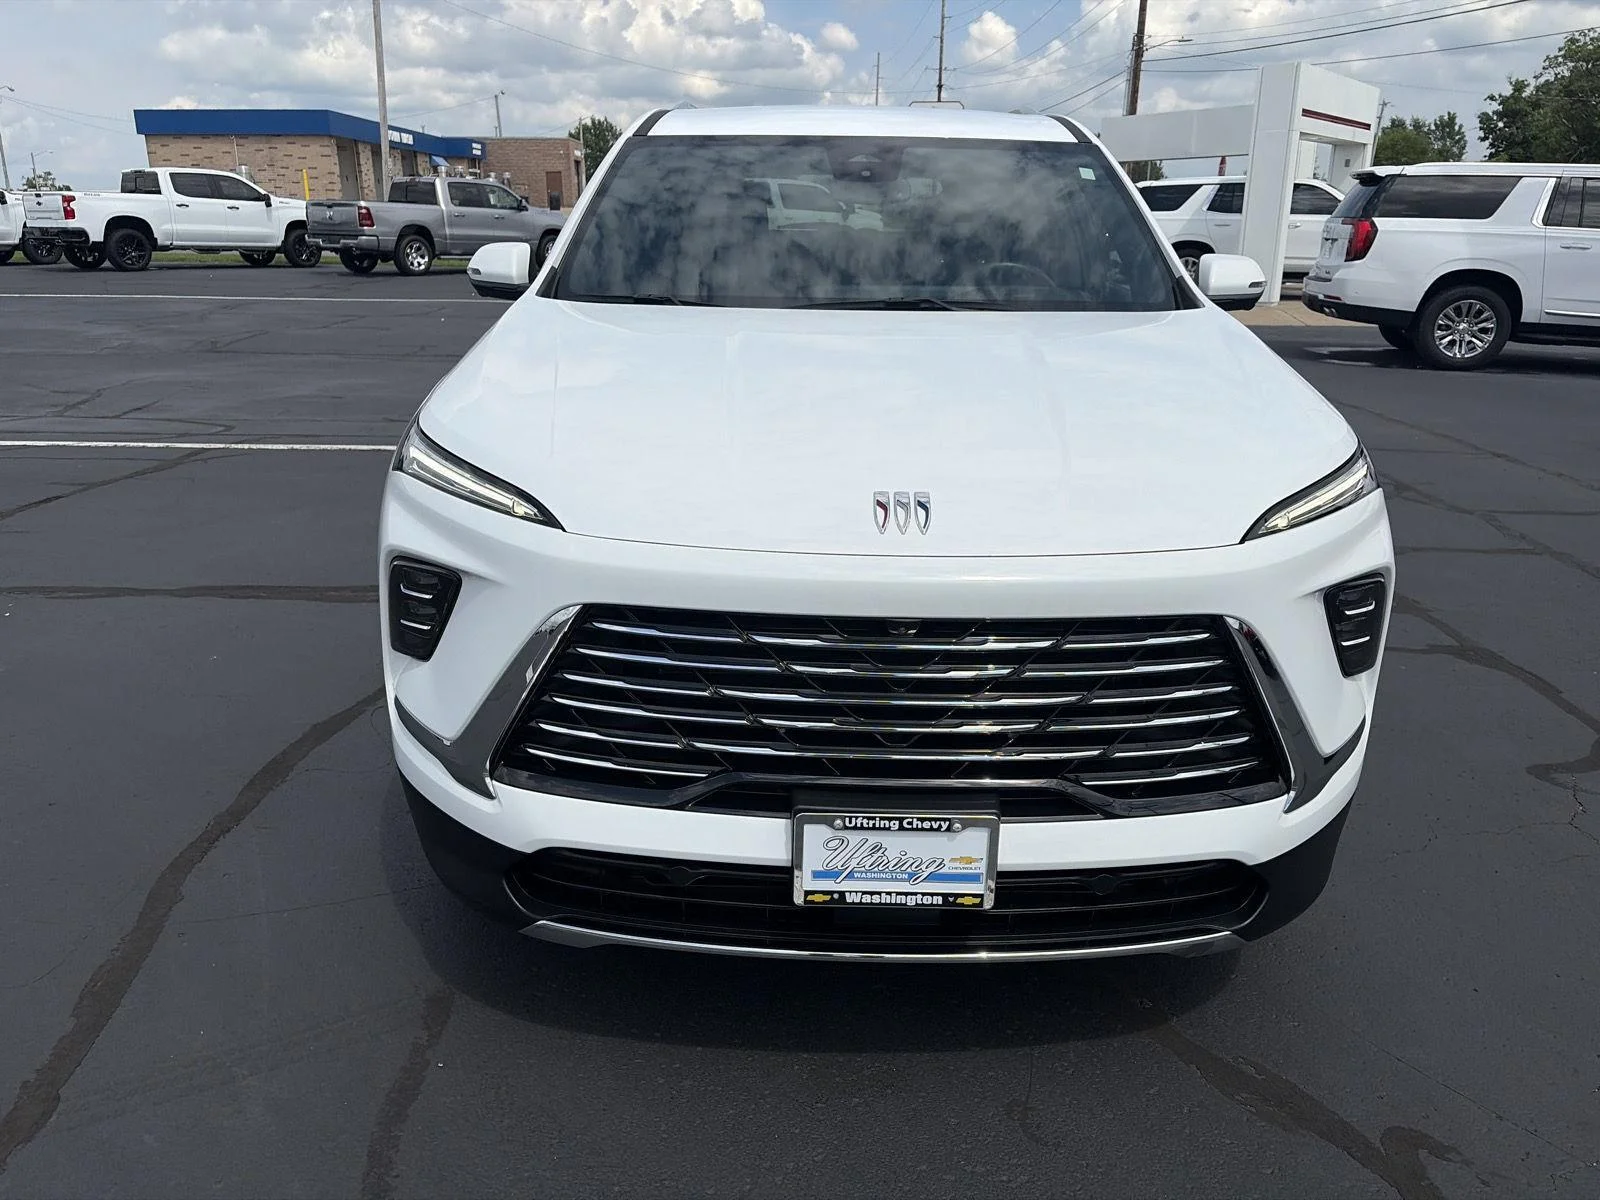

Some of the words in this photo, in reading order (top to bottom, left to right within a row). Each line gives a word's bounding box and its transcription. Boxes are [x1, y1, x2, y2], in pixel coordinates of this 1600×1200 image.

[845, 817, 899, 831] Uftring
[902, 818, 950, 832] Chevy
[821, 835, 946, 885] Uftring
[853, 872, 909, 880] WASHINGTON
[844, 892, 943, 906] Washington
